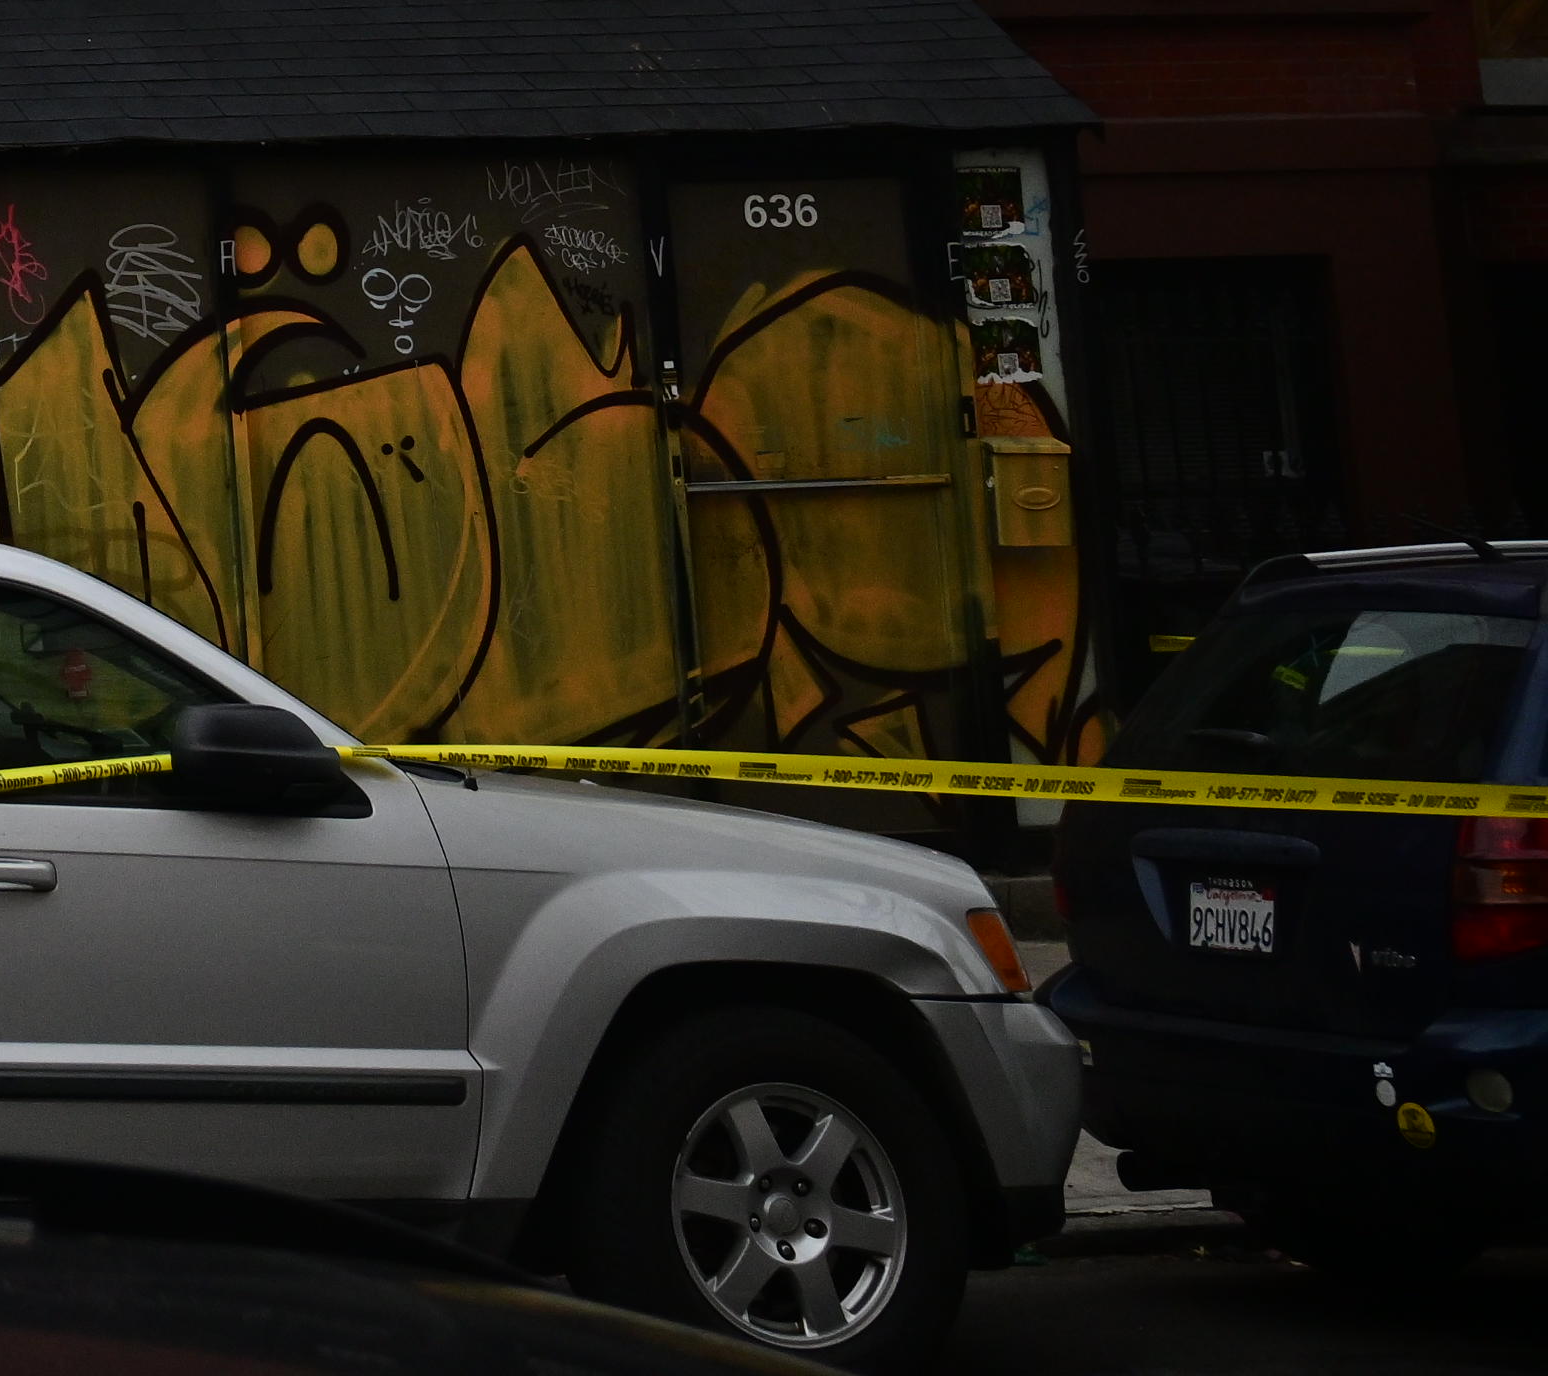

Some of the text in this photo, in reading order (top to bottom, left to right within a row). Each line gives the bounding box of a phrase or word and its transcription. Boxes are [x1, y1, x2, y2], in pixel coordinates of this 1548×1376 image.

[742, 192, 819, 229] 636
[822, 768, 933, 786] 1-800-577-TIPS (8477)
[1192, 906, 1272, 947] 9CHV846
